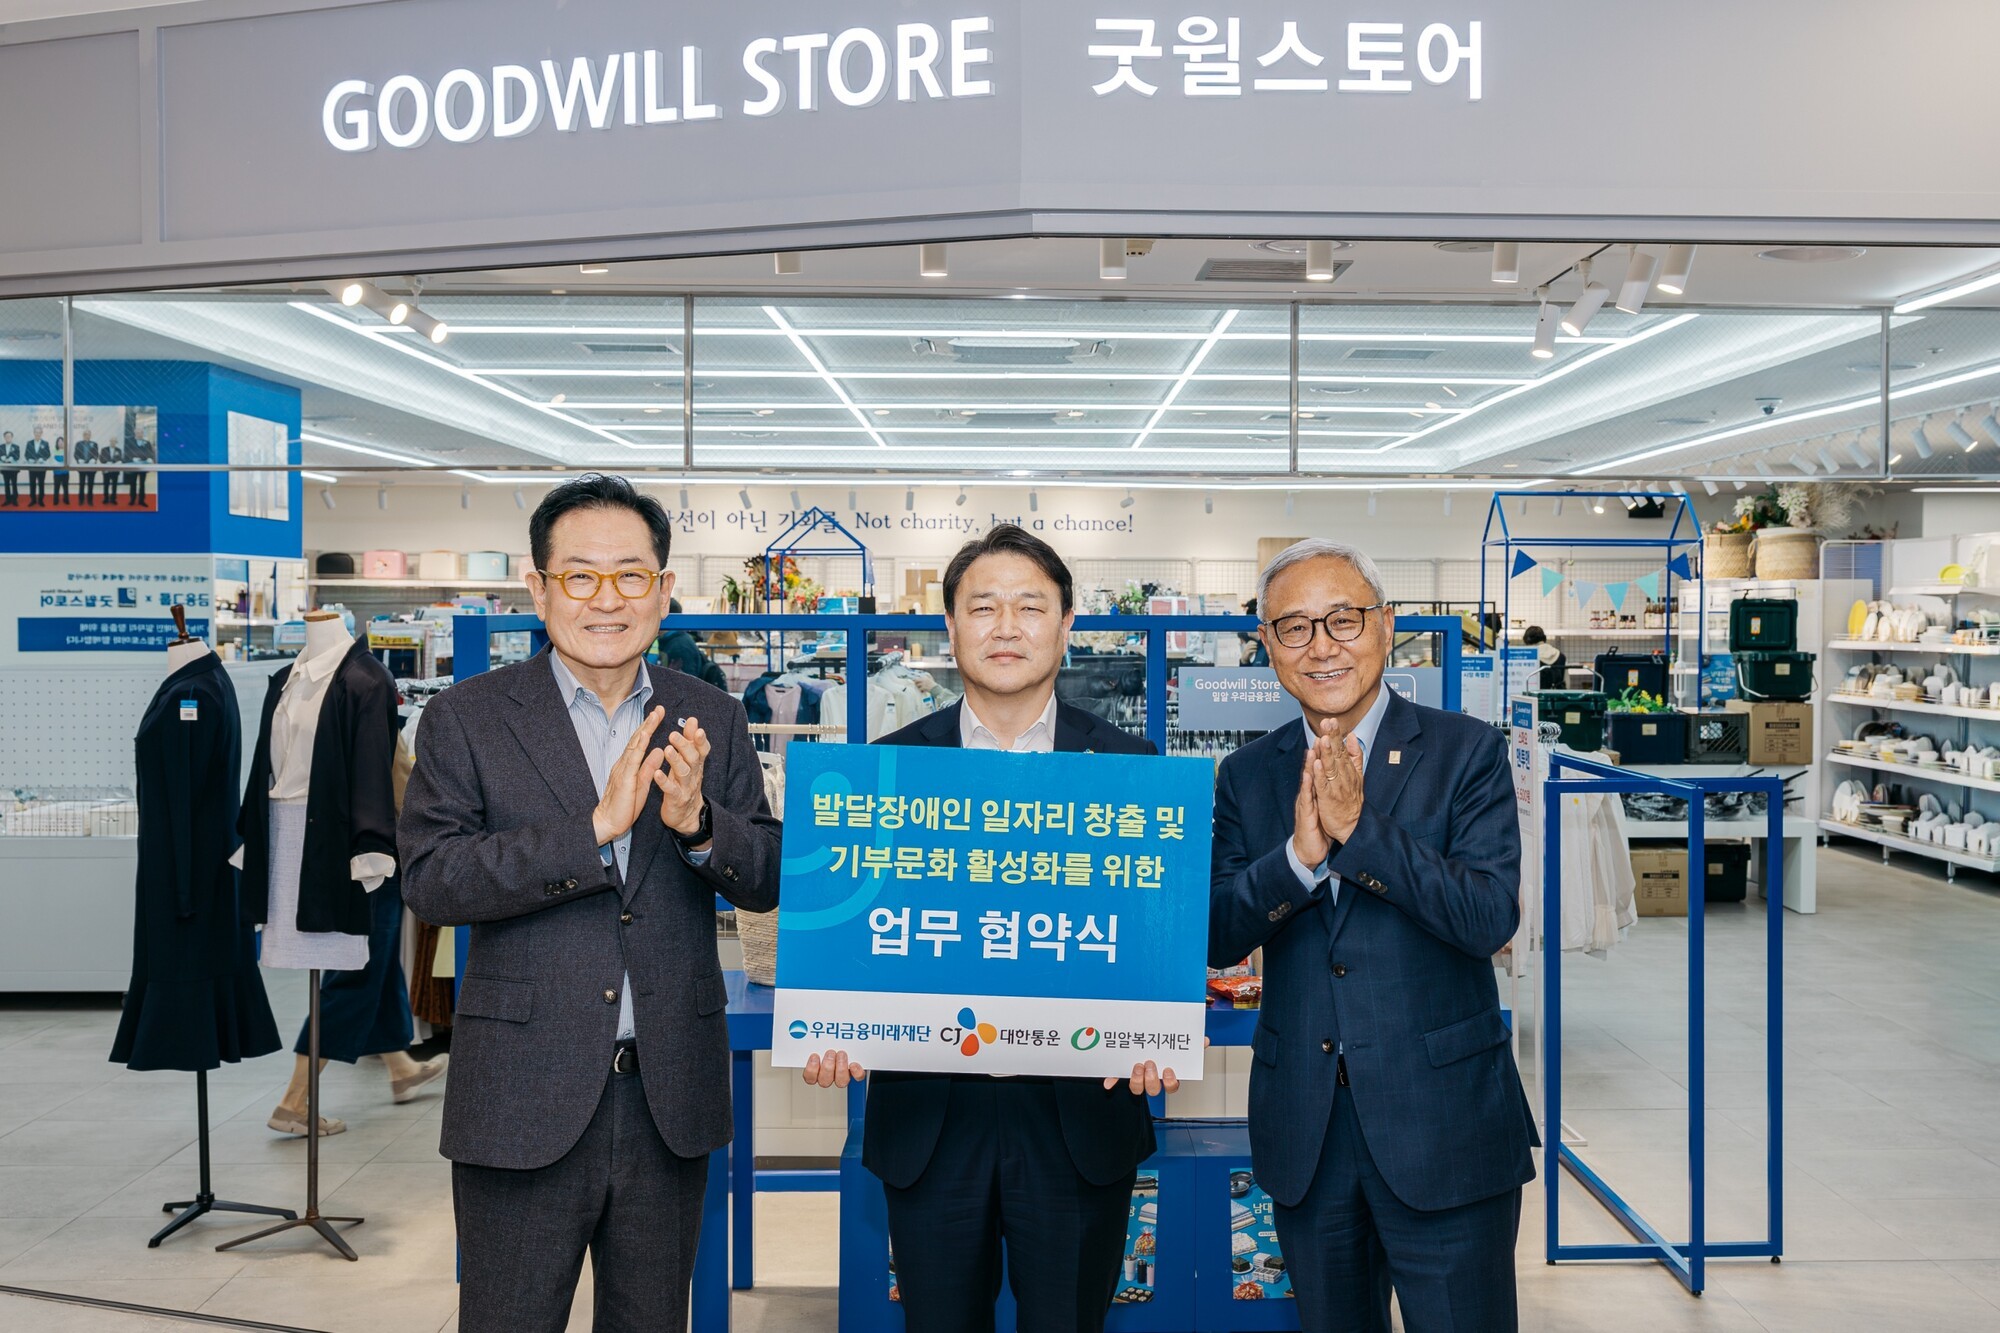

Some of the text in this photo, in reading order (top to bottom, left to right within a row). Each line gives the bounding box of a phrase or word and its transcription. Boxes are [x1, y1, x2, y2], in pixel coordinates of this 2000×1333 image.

[1087, 16, 1483, 101] 굿윌스토어
[322, 16, 995, 152] GOODWILL STORE
[727, 510, 768, 533] 아닌
[855, 512, 892, 529] Not
[900, 512, 981, 534] charity,
[1033, 518, 1044, 531] a
[1054, 513, 1133, 532] chance!
[1250, 678, 1281, 690] Store
[1212, 691, 1281, 702] 밀알 우리금융점은
[813, 793, 1186, 840] 발달장애인 일자리 창출 및
[829, 846, 1165, 889] 기부문화 활성화를 위한
[868, 907, 1118, 963] 업무 협약식
[810, 1021, 932, 1043] 우리금융미래재단
[940, 1027, 1061, 1047] CJ 대한통운
[1103, 1031, 1191, 1051] 밀알복지재단
